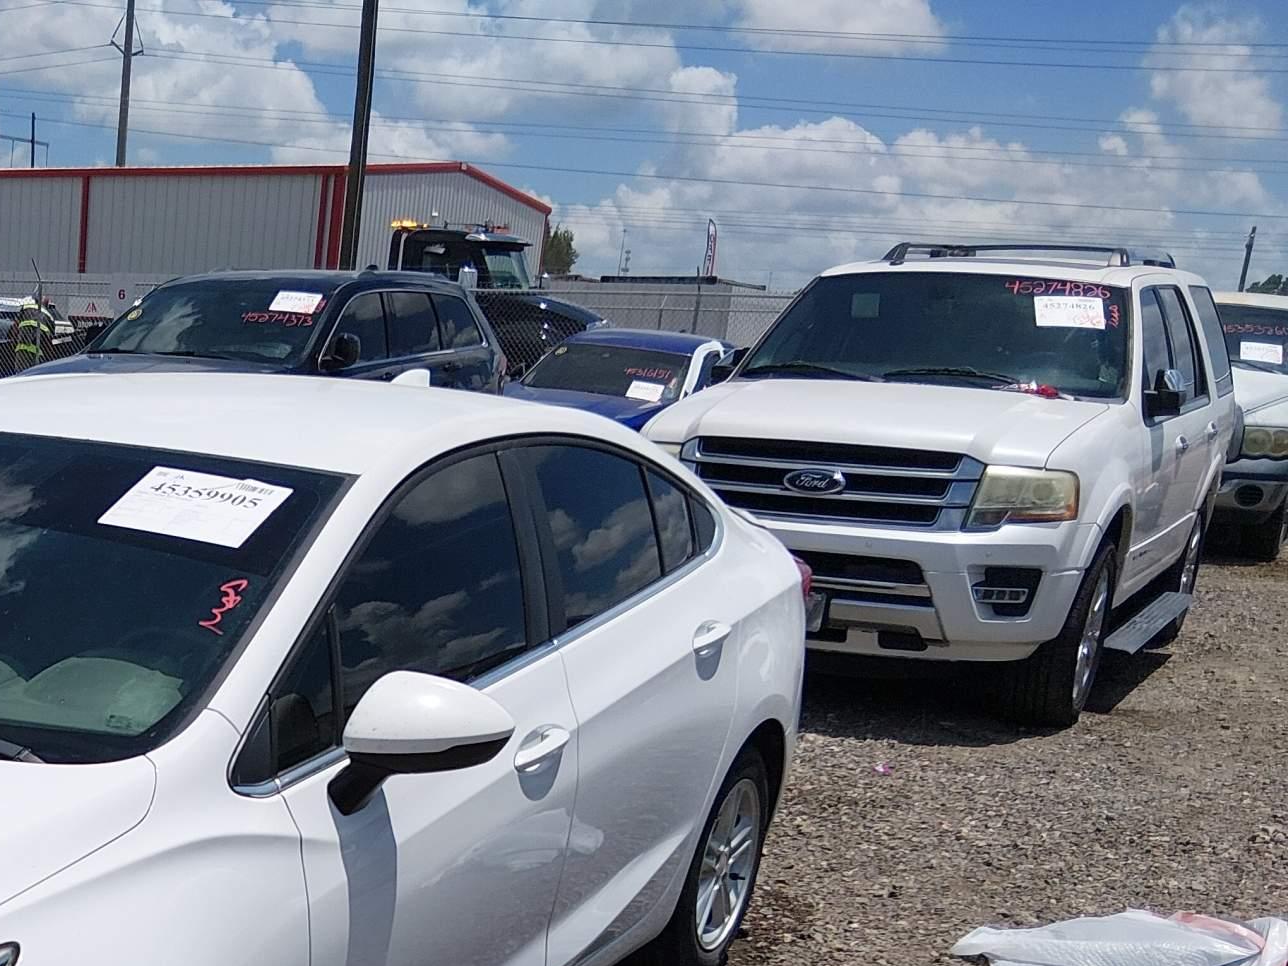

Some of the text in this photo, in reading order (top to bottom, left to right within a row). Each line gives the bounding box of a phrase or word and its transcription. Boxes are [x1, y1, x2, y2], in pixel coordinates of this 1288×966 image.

[118, 289, 126, 300] 6
[1005, 280, 1110, 299] 45274826
[241, 311, 313, 327] 45274373
[795, 473, 830, 488] Ford
[150, 482, 263, 509] 45359905
